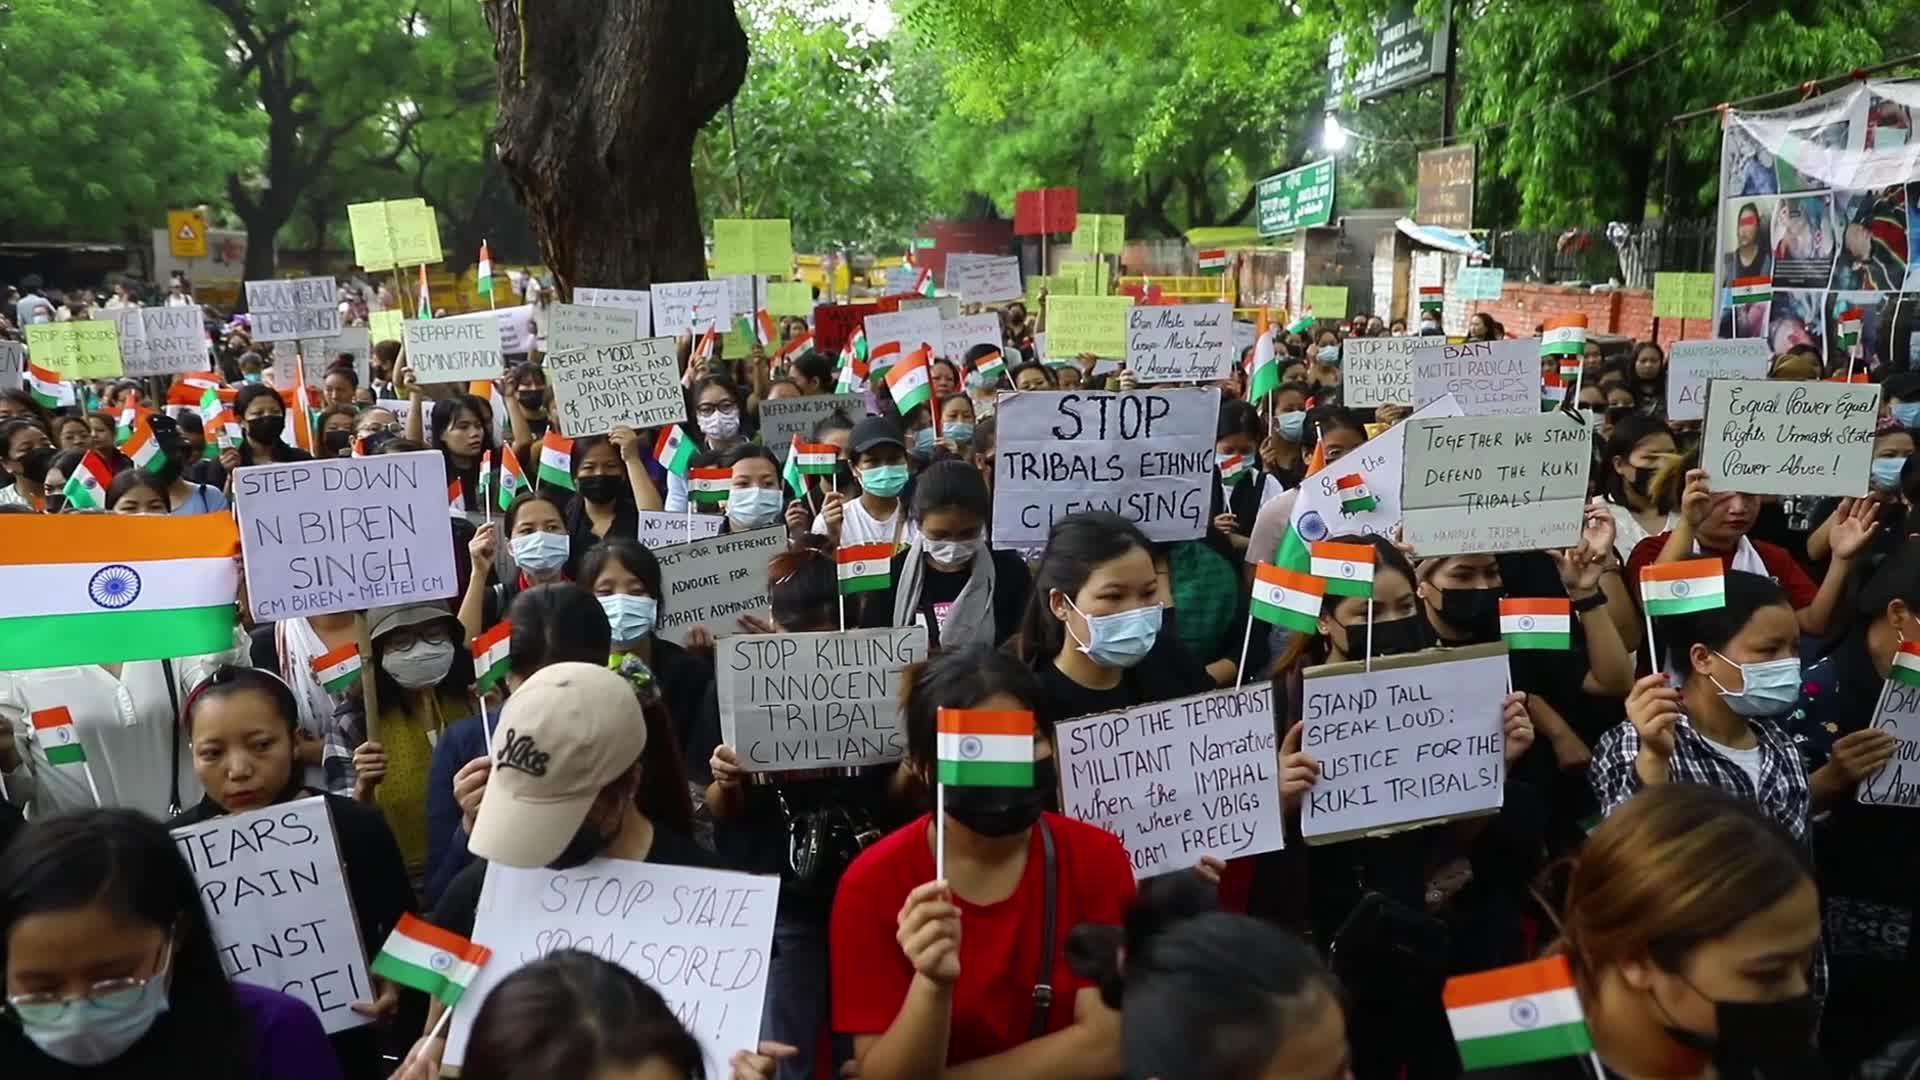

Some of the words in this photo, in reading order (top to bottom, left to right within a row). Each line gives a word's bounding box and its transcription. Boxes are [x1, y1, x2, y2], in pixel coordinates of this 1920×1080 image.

[123, 336, 193, 356] EPARATE
[410, 324, 485, 343] SEPARATE
[1350, 341, 1381, 356] STOP
[551, 353, 587, 369] DEAR
[597, 344, 634, 363] MODI
[642, 342, 656, 357] JI
[1443, 342, 1492, 359] BAN
[560, 372, 576, 383] WE
[582, 366, 603, 379] ARE
[612, 360, 642, 374] SONS
[648, 356, 673, 370] AND
[1349, 374, 1369, 386] THE
[1468, 358, 1529, 375] RADICAL
[578, 372, 671, 396] DAUGHTERS
[1446, 378, 1529, 393] GROUPS
[564, 399, 580, 417] of
[588, 391, 634, 412] INDIA
[637, 390, 653, 404] DO
[657, 386, 681, 400] OUR
[1052, 394, 1170, 440] STOP
[1730, 388, 1779, 422] Equal
[1786, 388, 1832, 416] Power
[1836, 393, 1878, 418] Equal
[567, 416, 609, 437] LIVES
[634, 402, 684, 424] MATTER?
[1723, 420, 1766, 448] Rights
[1422, 425, 1503, 452] TOGETHER
[1515, 433, 1533, 446] WE
[242, 468, 311, 496] STEP
[322, 460, 417, 492] DOWN
[1003, 452, 1124, 482] TRIBALS
[1139, 449, 1213, 478] ETHNIC
[1361, 454, 1386, 473] the
[1424, 465, 1483, 487] DEFEND
[1498, 465, 1526, 478] THE
[1541, 461, 1579, 476] KUKI
[1723, 450, 1770, 477] Power
[255, 515, 283, 546] N
[299, 503, 417, 545] BIREN
[643, 518, 662, 531] NO
[689, 547, 711, 559] OUR
[717, 535, 778, 556] DIFFERENCES
[289, 548, 414, 590] SINGH
[671, 575, 722, 596] ADVOCATE
[729, 568, 751, 582] FOR
[258, 598, 287, 617] CM
[292, 589, 344, 612] BIREN
[359, 580, 416, 601] MEITEI
[422, 576, 444, 593] CM
[660, 607, 706, 630] PARATE
[730, 640, 797, 671] STOP
[815, 633, 914, 670] KILLING
[759, 701, 895, 732] TRIBAL
[1308, 689, 1377, 720] STAND
[1387, 684, 1432, 706] TALL
[1070, 717, 1130, 756] STOP
[1136, 709, 1174, 737] THE
[1181, 687, 1273, 728] TERRORIST
[1308, 719, 1377, 747] SPEAK
[497, 728, 551, 775] Nike
[750, 731, 904, 764] CIVILIANS
[1071, 744, 1173, 789] MILITANT
[1189, 729, 1275, 766] Narrative
[1320, 748, 1399, 782] USTICE
[1416, 738, 1462, 763] FOR
[1466, 732, 1501, 756] THE
[1145, 782, 1177, 807] the
[1194, 763, 1269, 796] IMPHAL
[1310, 785, 1377, 818] KUKI
[1384, 764, 1499, 803] TRIBALS!
[175, 813, 319, 872] TEARS,
[200, 861, 319, 915] PAIN
[541, 875, 654, 918] STOP
[662, 884, 764, 928] STATE
